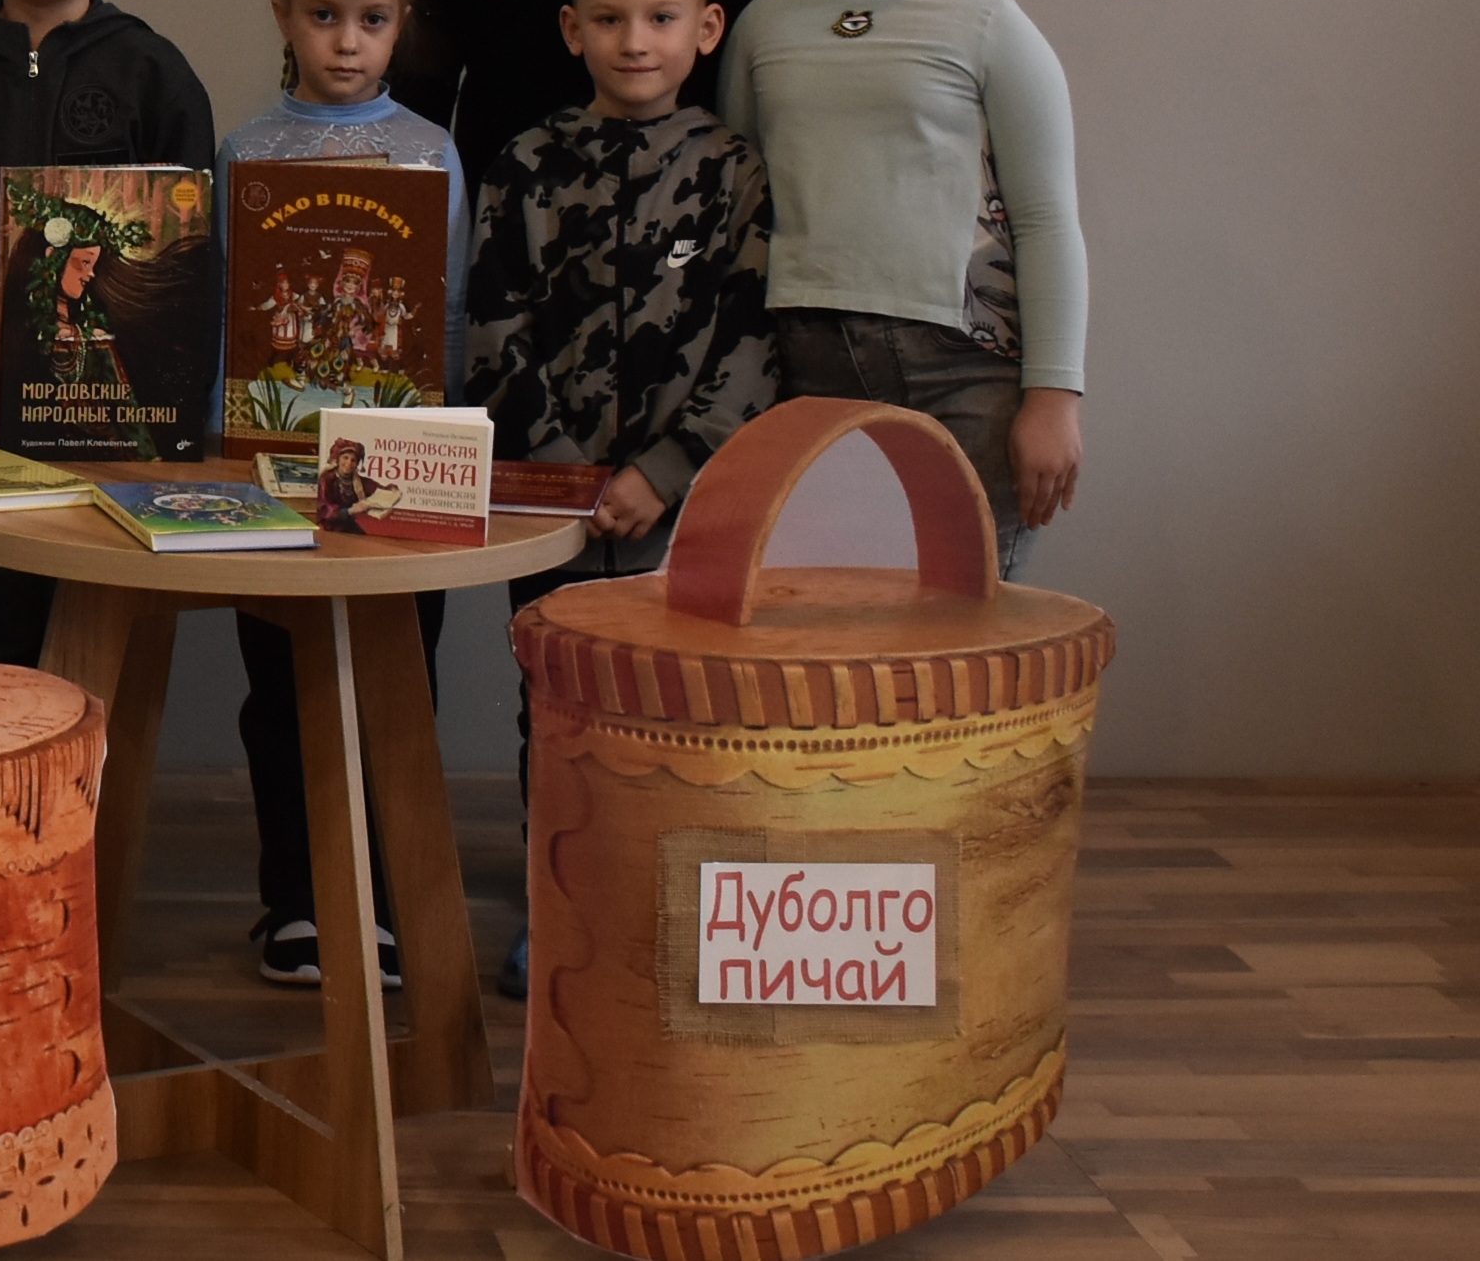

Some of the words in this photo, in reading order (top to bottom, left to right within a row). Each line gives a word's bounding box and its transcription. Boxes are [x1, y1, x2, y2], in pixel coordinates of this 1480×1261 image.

[261, 197, 311, 230] ЧУДО
[316, 193, 331, 206] В
[335, 193, 414, 239] ПЕРЬЯХ
[286, 226, 339, 235] Мордовские
[672, 239, 697, 255] NIKE
[22, 382, 132, 401] МОРДОВСКИЕ
[22, 406, 111, 424] НАРОДНЫЕ
[116, 406, 177, 423] СКАЗКИ
[21, 439, 56, 447] Художник
[58, 438, 85, 447] Павел
[87, 439, 138, 447] Клементьев
[374, 438, 478, 460] МОРДОВСКАЯ
[367, 455, 477, 487] АЗБУКА
[406, 487, 476, 500] МОКШАНСКАЯ
[409, 497, 416, 505] И
[420, 498, 476, 510] ЭРЗЯНСКАЯ
[707, 870, 933, 951] Дуболго
[720, 940, 906, 1001] пичай
